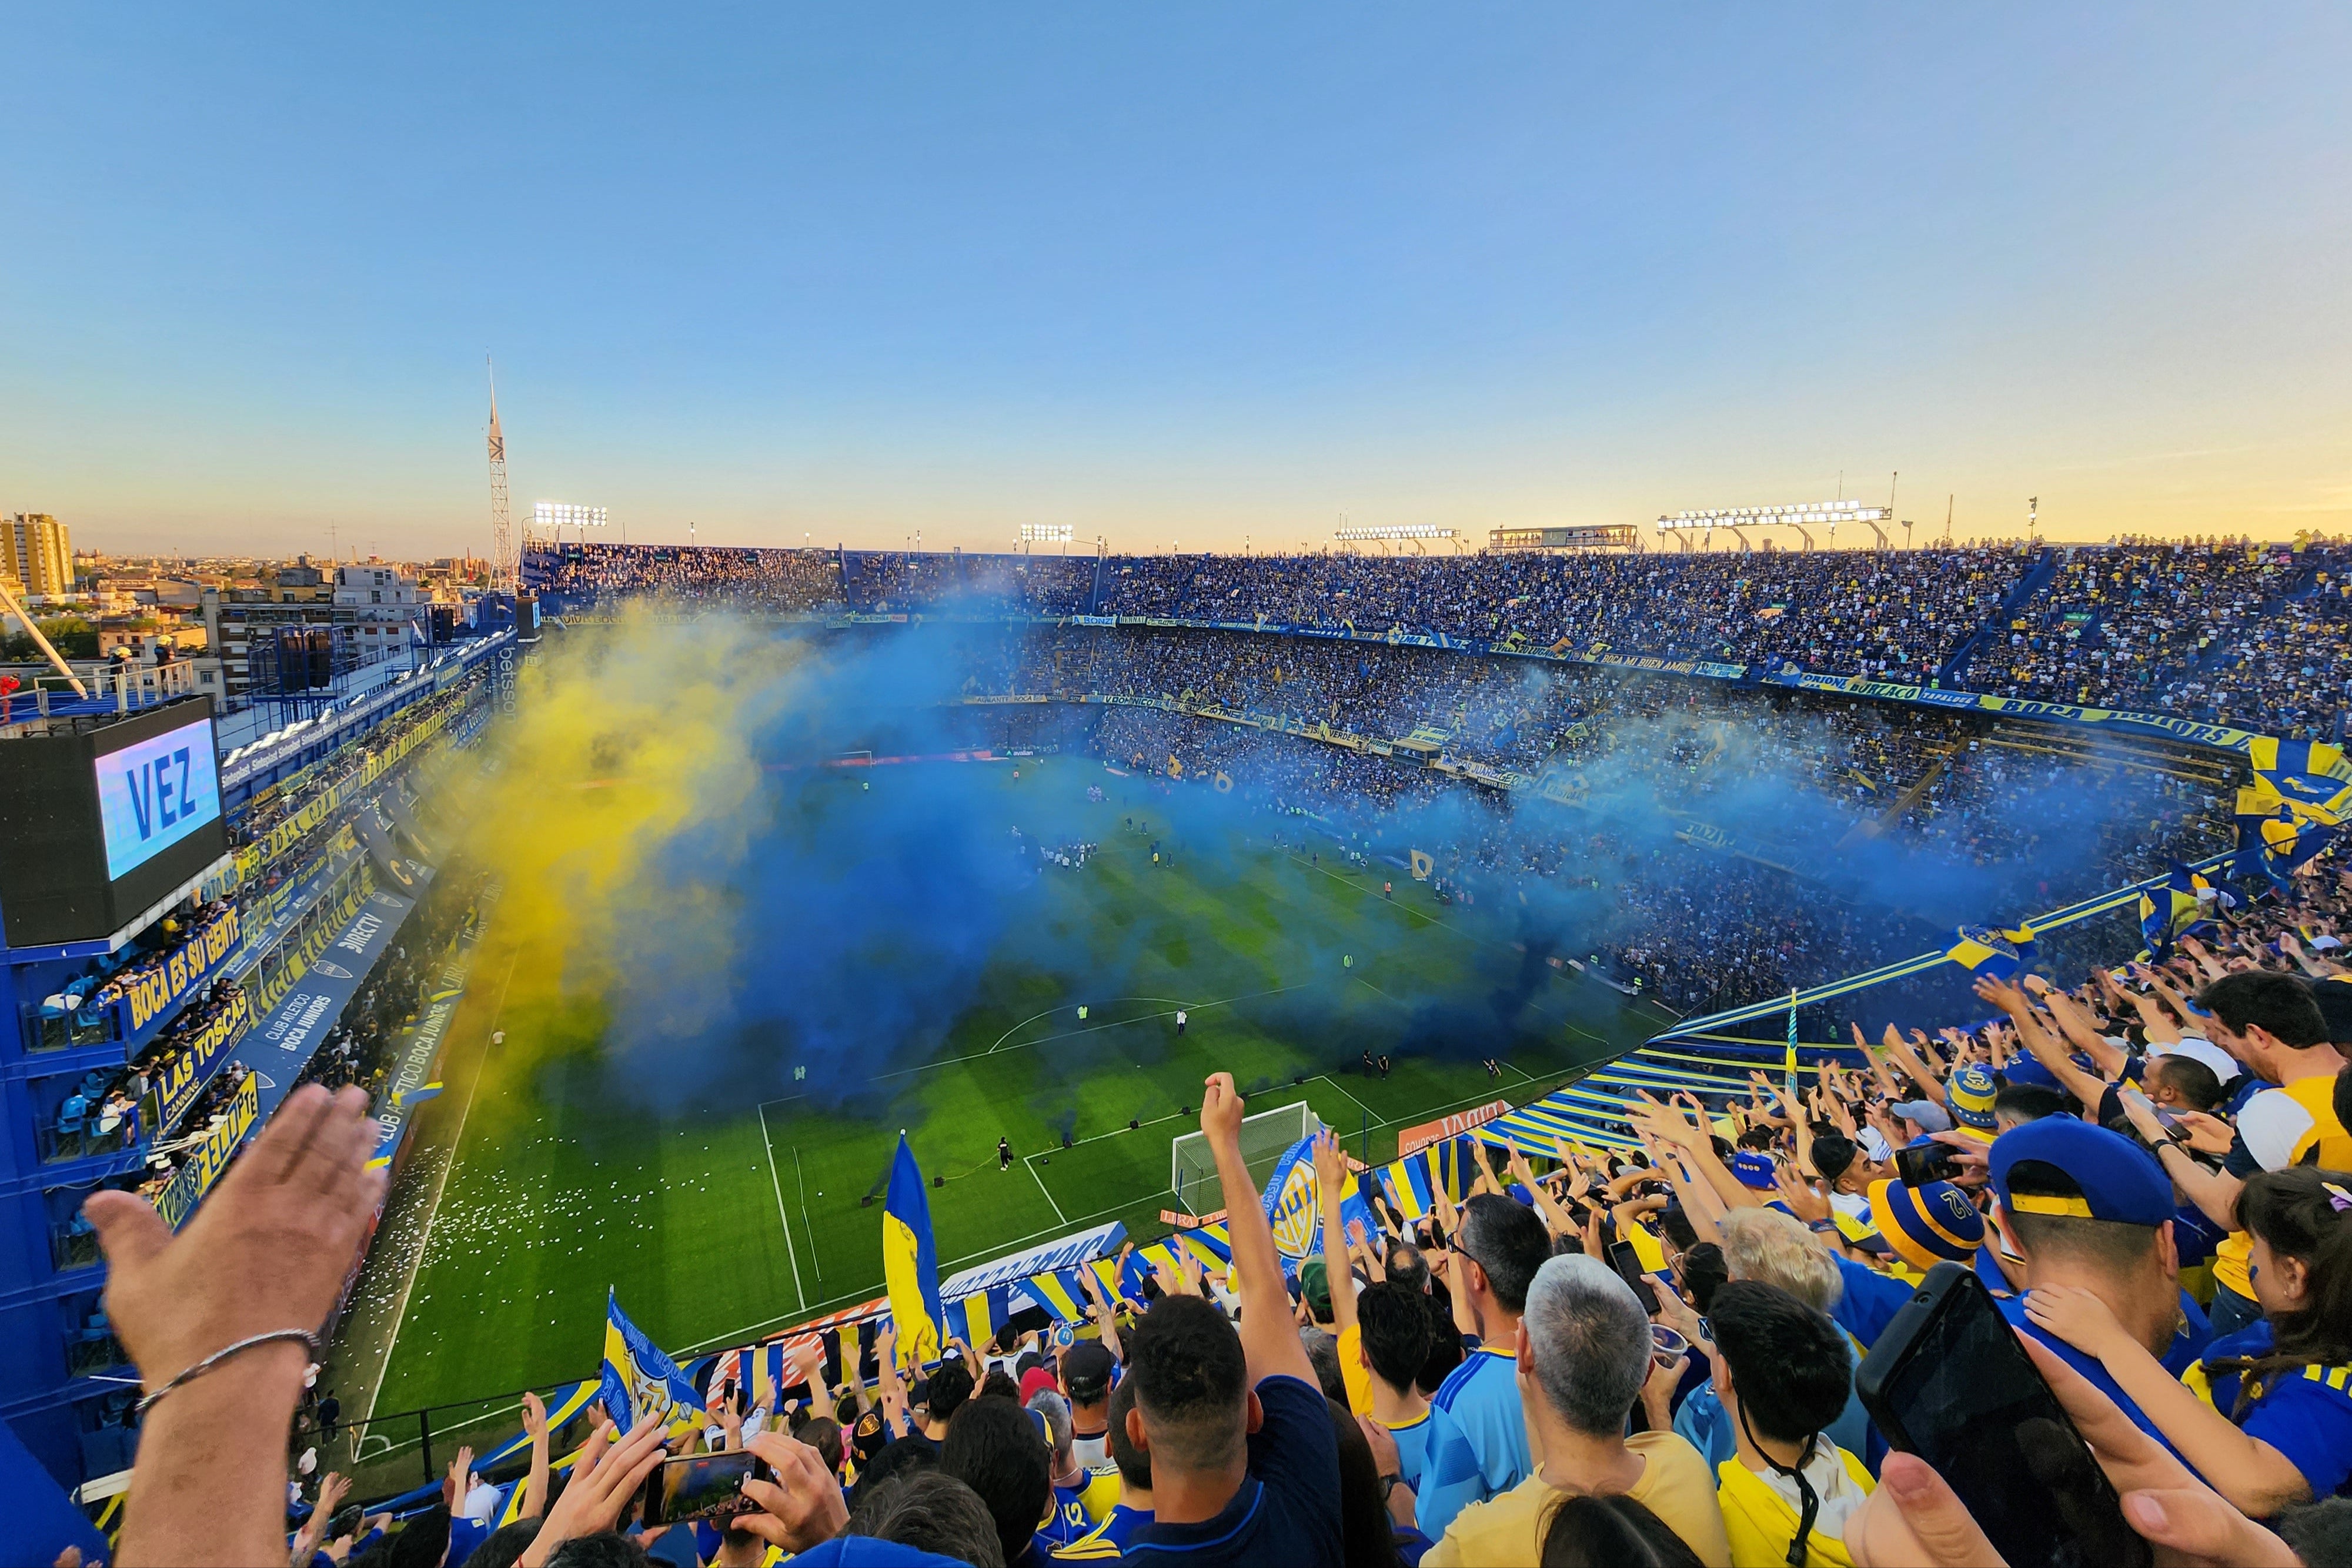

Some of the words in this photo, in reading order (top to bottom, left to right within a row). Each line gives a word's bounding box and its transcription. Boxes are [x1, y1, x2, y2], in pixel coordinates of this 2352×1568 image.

[1084, 616, 1115, 625] BONZI
[1601, 654, 1623, 664] BOCA
[1625, 656, 1638, 666] MI
[1638, 658, 1662, 669] BUEN
[1663, 661, 1696, 674] AMIGO
[499, 647, 517, 723] betsson
[1849, 681, 1918, 699] BURZACO
[2000, 698, 2084, 721] BOCA
[278, 738, 301, 758] Sinteplast
[301, 727, 323, 745] Sinteplast
[1329, 730, 1352, 742] VERDE
[1369, 738, 1392, 749] HUDSON
[252, 750, 278, 771] Sinteplast
[222, 763, 251, 788] Sinteplast
[126, 747, 197, 842] VEZ
[337, 912, 383, 954] DIRECTV
[130, 968, 171, 1030] BOCA
[169, 951, 187, 997] ES
[188, 936, 205, 979] SU
[206, 905, 240, 965] GENTE
[265, 1014, 288, 1040] CLUB
[284, 992, 311, 1023] ATLÉTICO
[279, 1026, 307, 1052] BOCA
[300, 994, 332, 1032] JUNIORS
[408, 1032, 434, 1065] BOCA
[425, 1002, 452, 1039] JUNIOR
[159, 1051, 195, 1106] LAS
[195, 988, 248, 1067] TOSCAS
[165, 1076, 201, 1121] CANNING
[1164, 1211, 1193, 1227] LIBRA
[1063, 1502, 1088, 1527] 12
